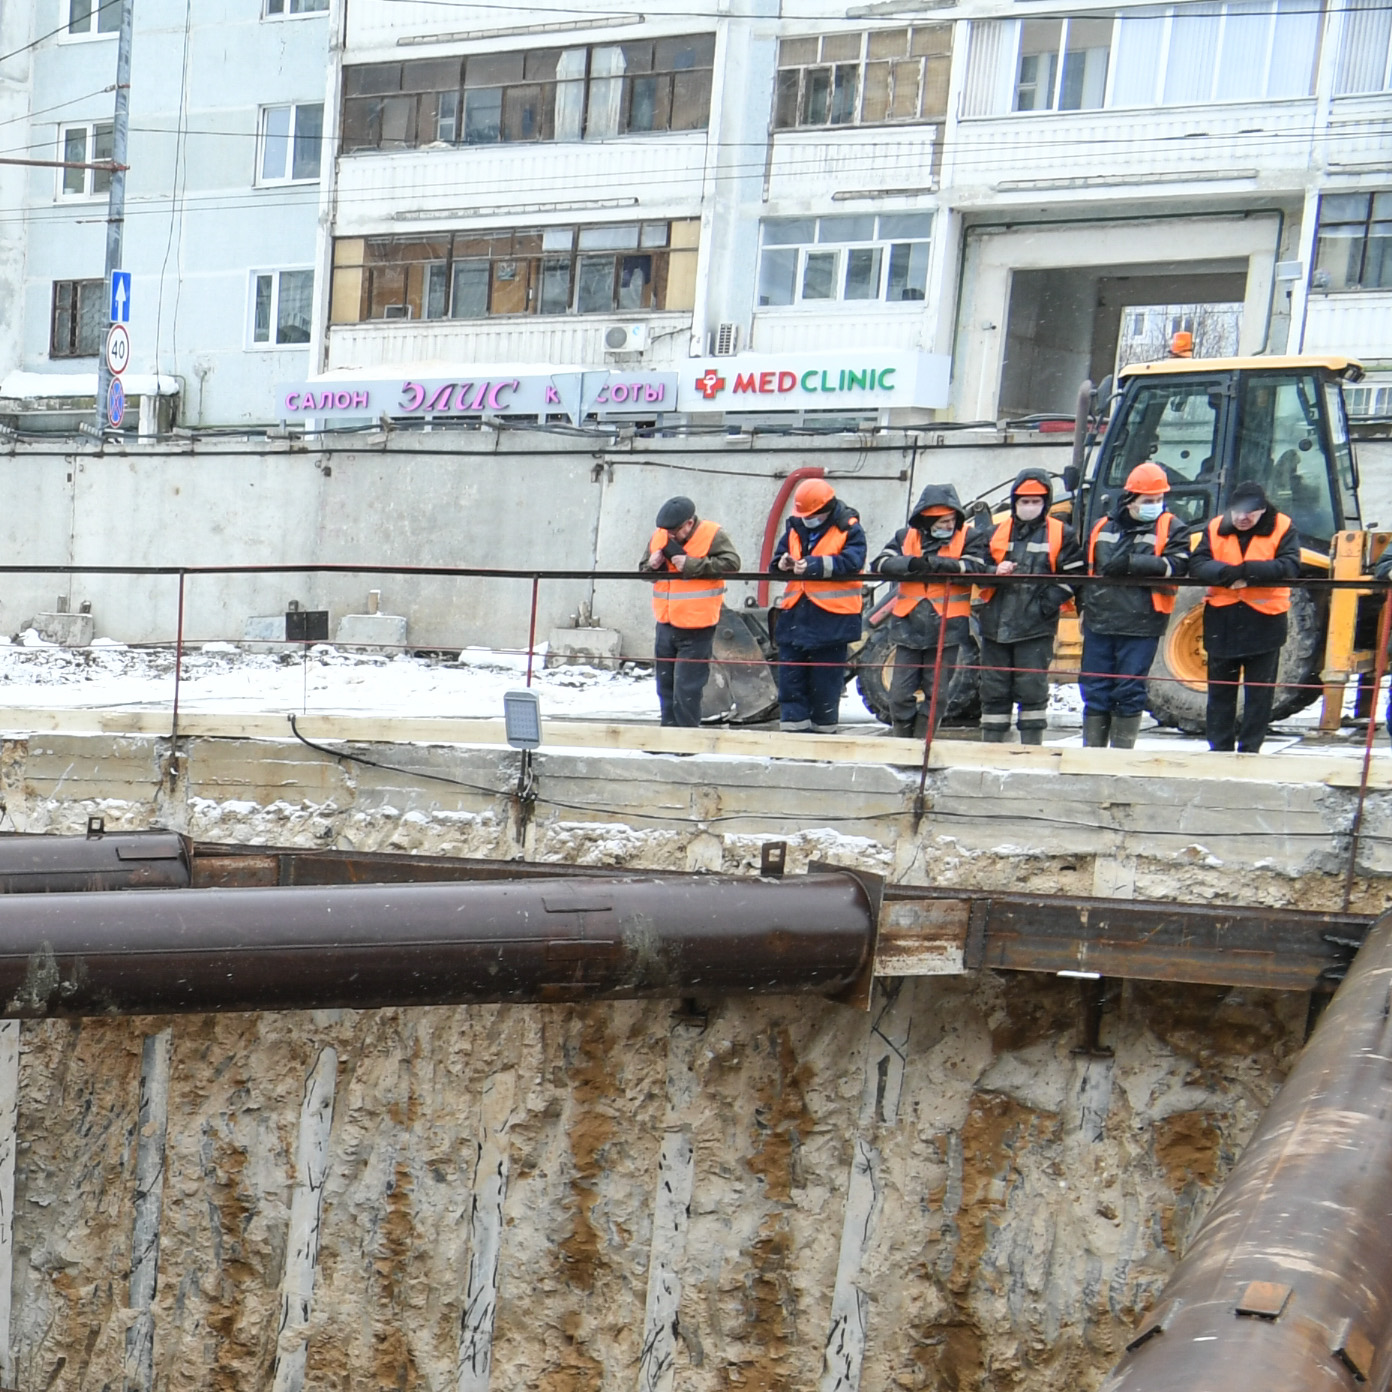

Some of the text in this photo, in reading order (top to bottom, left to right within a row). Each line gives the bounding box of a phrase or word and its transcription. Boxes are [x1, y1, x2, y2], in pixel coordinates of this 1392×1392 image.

[110, 340, 125, 359] 40
[285, 379, 665, 412] САЛОН ЭЛИС КСОТЫ
